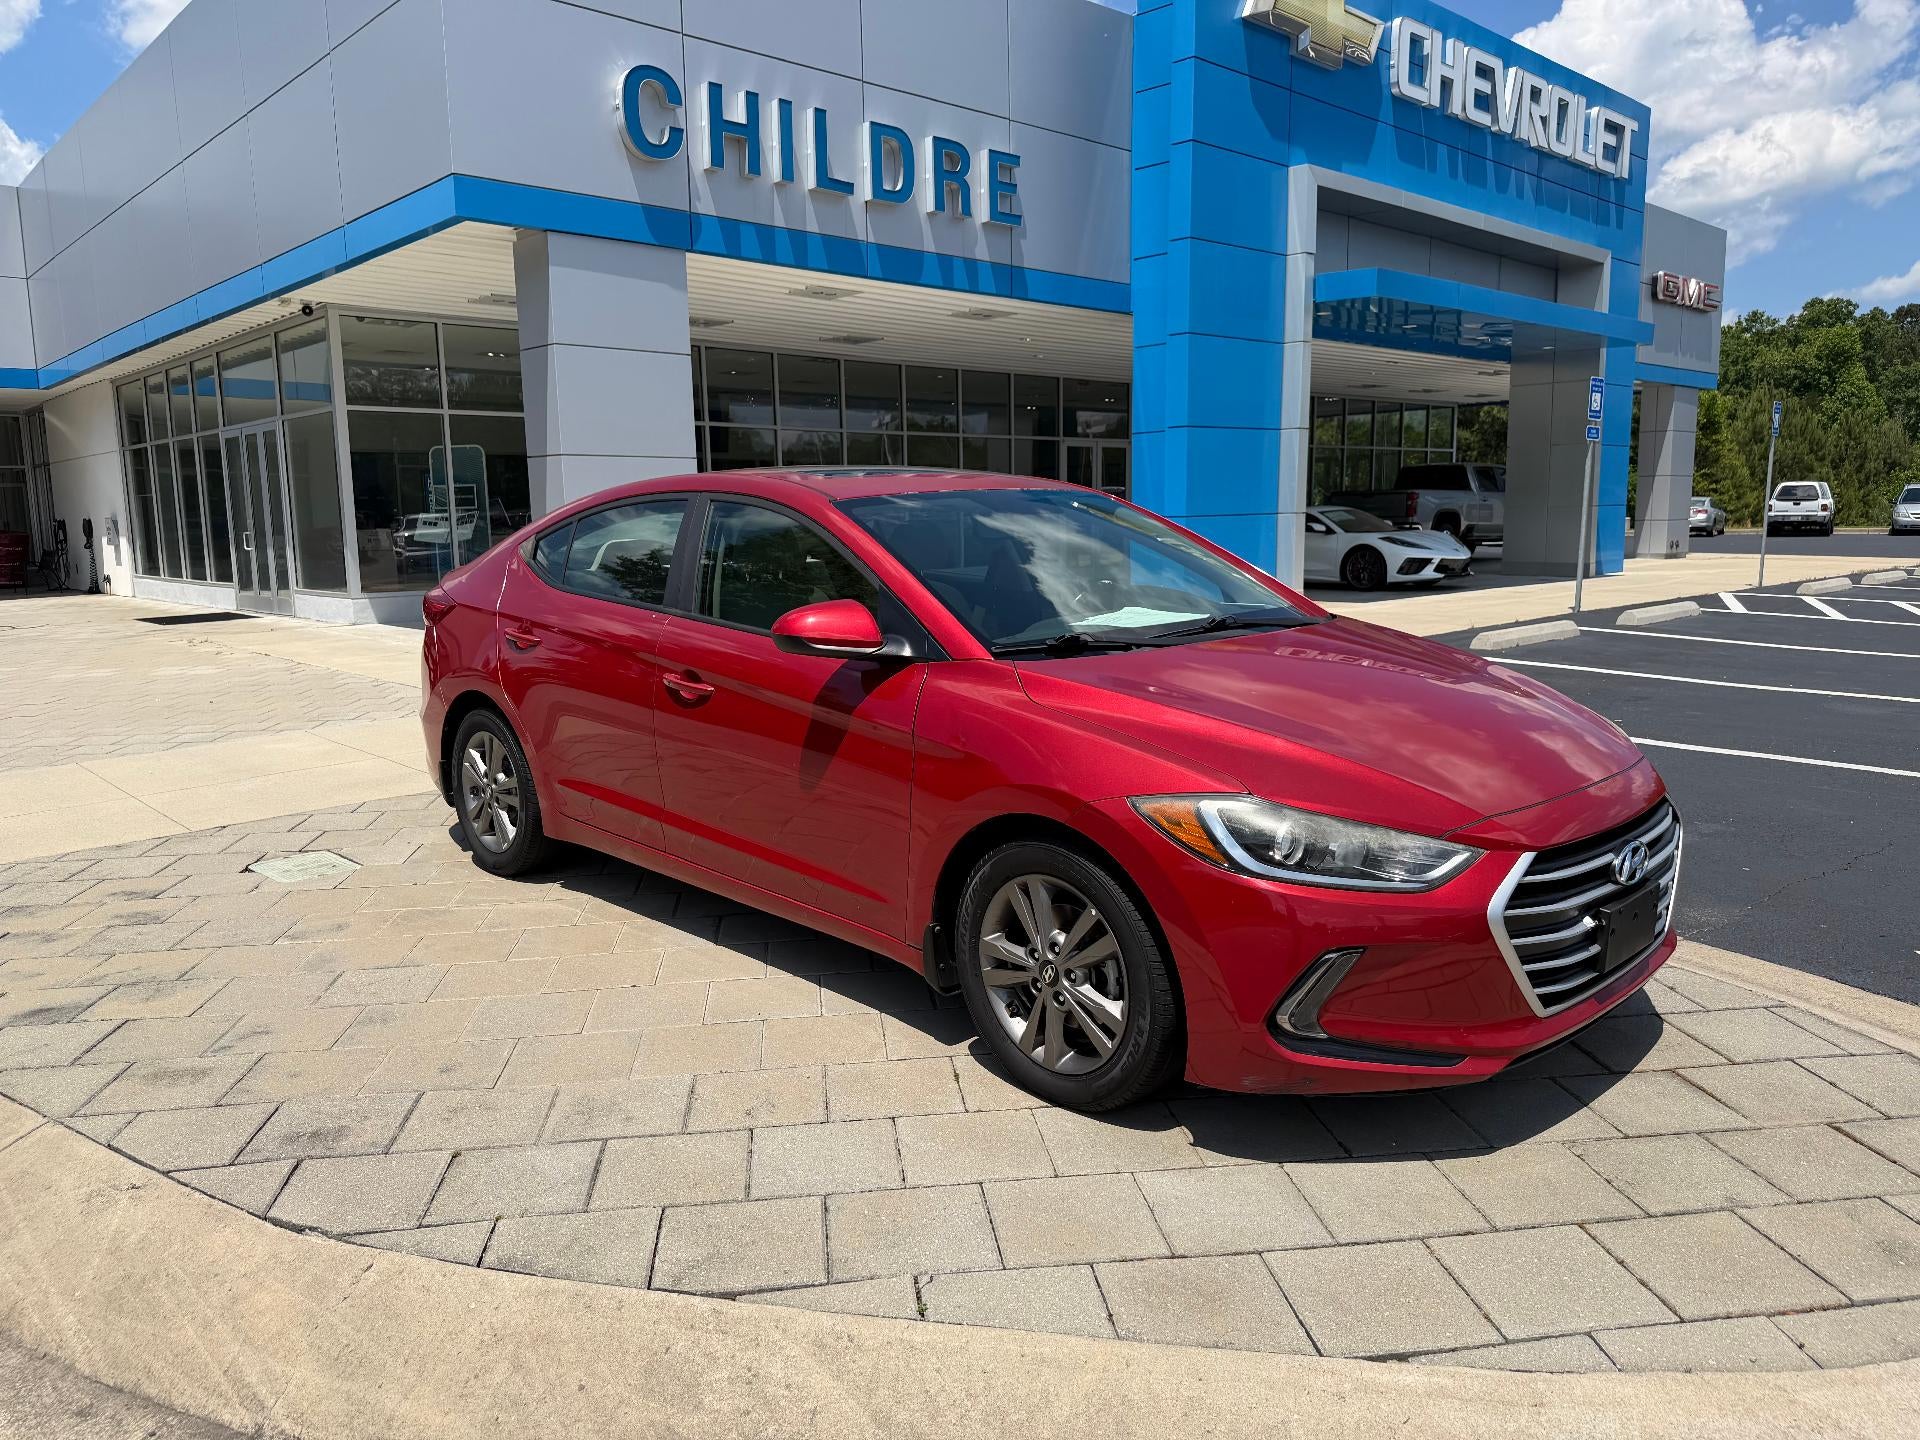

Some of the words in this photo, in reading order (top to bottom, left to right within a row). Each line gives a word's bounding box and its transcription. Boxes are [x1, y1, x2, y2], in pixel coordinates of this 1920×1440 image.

[617, 65, 1022, 227] CHILDRE
[1390, 16, 1638, 179] CHEVROLET
[1653, 271, 1720, 312] GMC
